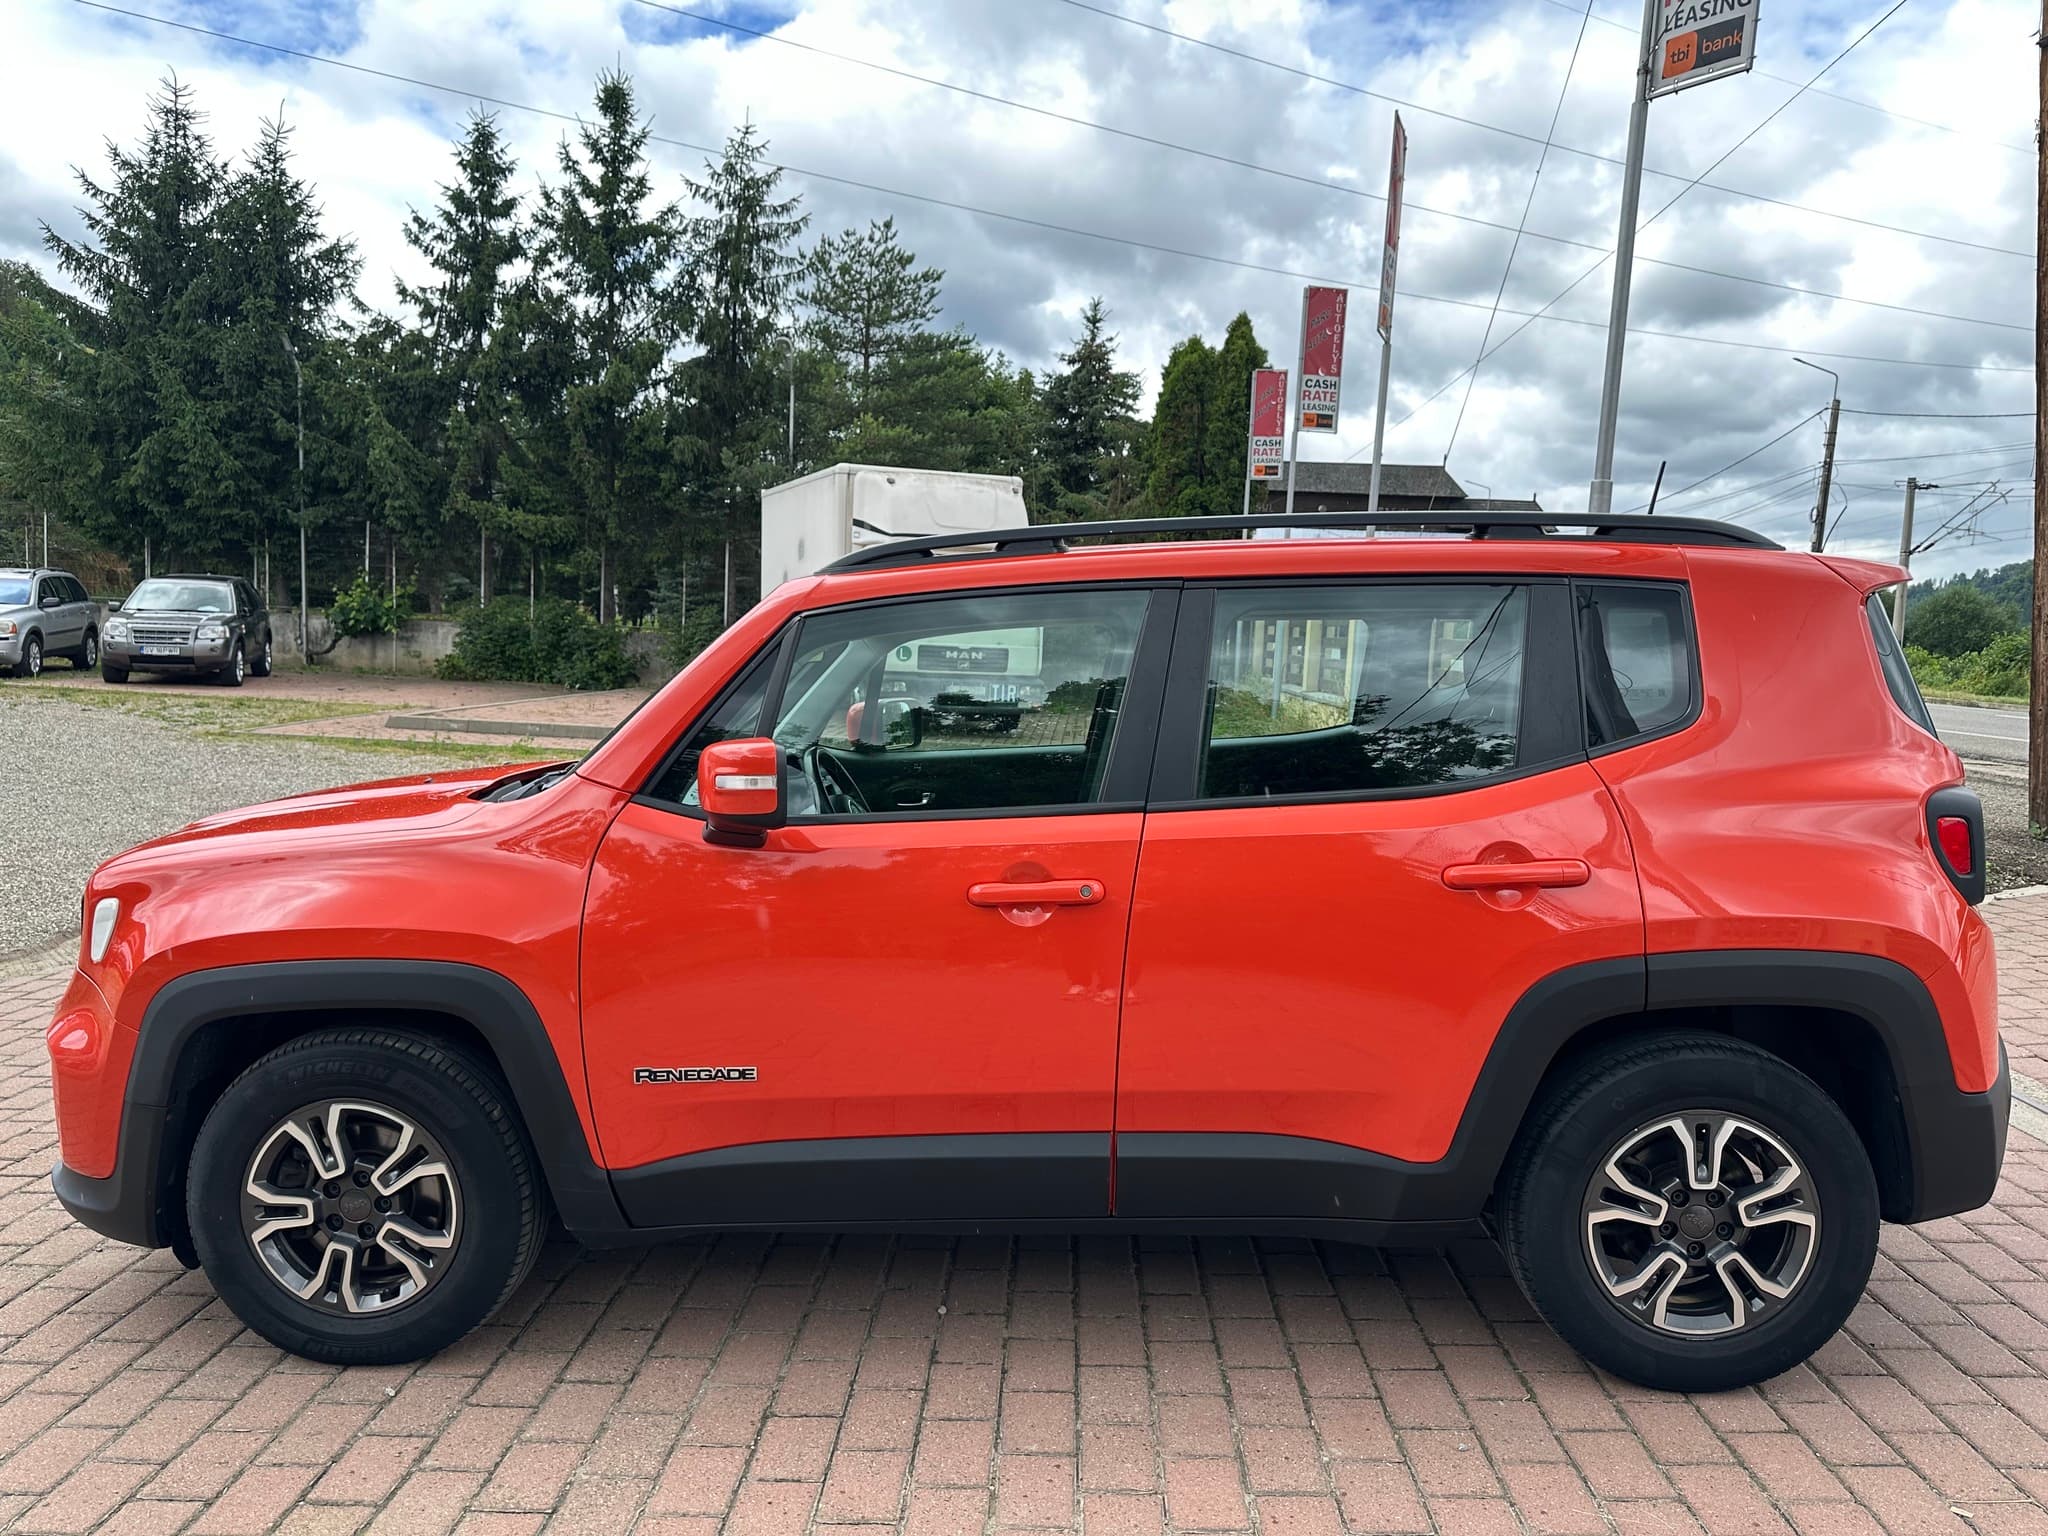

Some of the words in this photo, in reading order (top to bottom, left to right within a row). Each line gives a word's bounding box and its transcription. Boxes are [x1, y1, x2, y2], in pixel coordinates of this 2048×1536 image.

[1670, 44, 1690, 64] tbi
[1702, 30, 1742, 55] bank
[1304, 378, 1337, 390] CASH
[1302, 389, 1337, 403] RATE
[1302, 403, 1336, 413] LEASING
[1254, 439, 1282, 447] CASH
[1253, 447, 1282, 457] RATE
[945, 650, 984, 660] MAN
[992, 684, 1018, 703] TIR
[633, 1066, 758, 1084] RENEGADE
